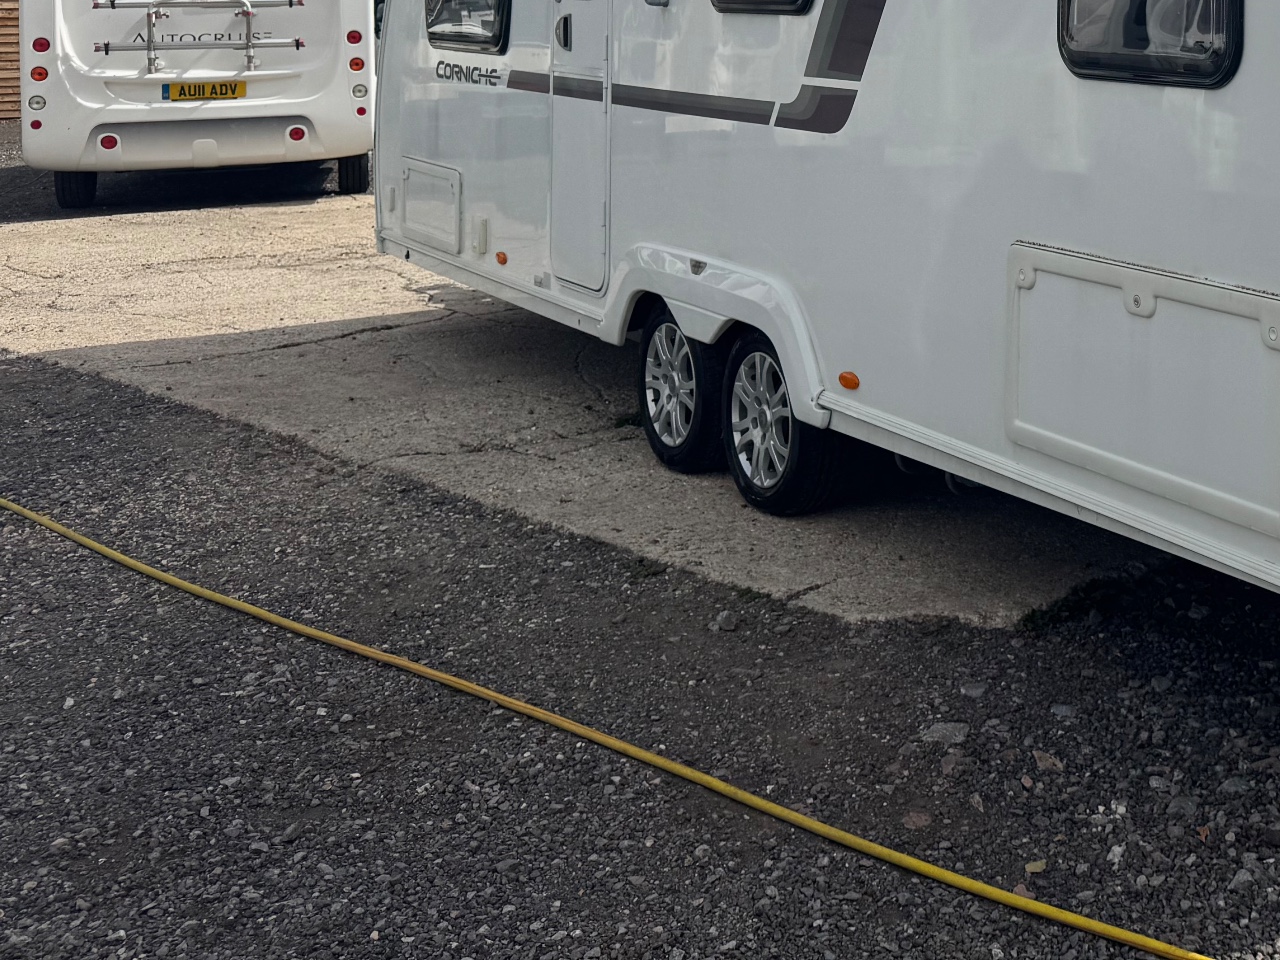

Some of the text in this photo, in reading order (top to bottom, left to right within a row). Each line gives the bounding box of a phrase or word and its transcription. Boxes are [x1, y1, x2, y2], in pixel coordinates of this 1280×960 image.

[133, 32, 272, 43] ATOCRUSE
[435, 60, 501, 87] CORNICHE
[179, 83, 237, 97] AU11 ADV
